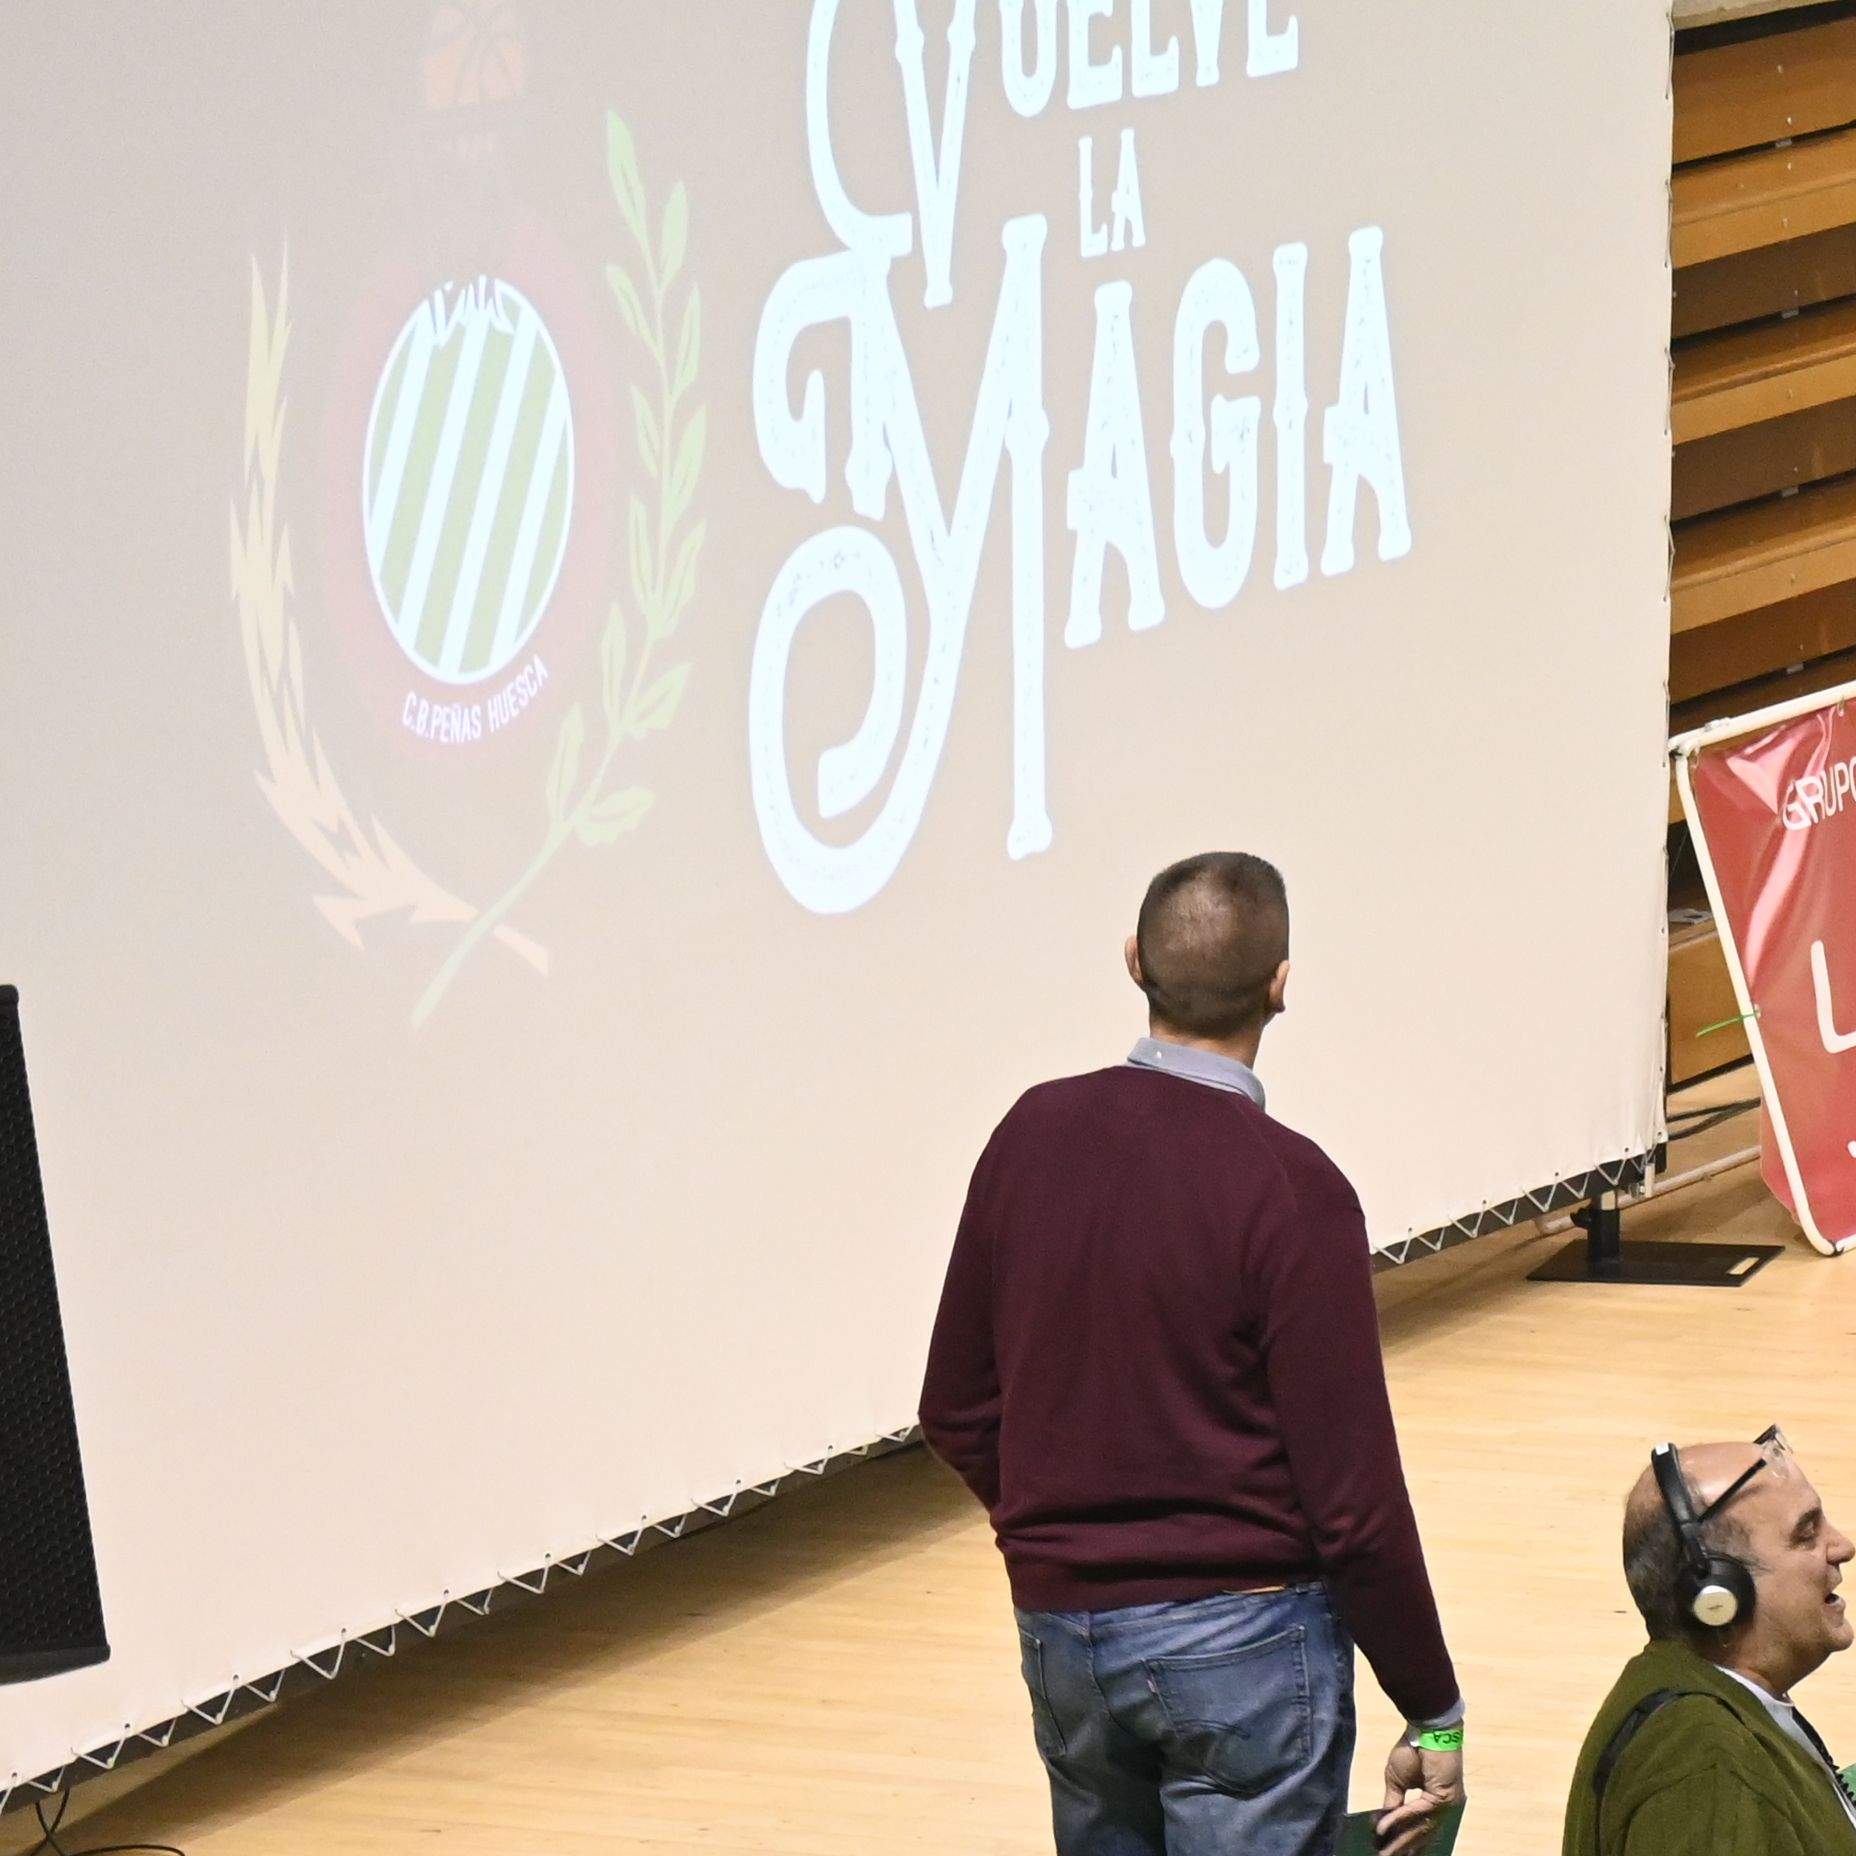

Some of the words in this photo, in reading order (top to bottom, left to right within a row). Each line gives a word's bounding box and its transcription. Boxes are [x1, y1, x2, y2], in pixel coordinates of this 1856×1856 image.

[1078, 127, 1146, 258] LA
[748, 213, 1413, 914] MAGIA
[487, 653, 549, 733] HUESCA
